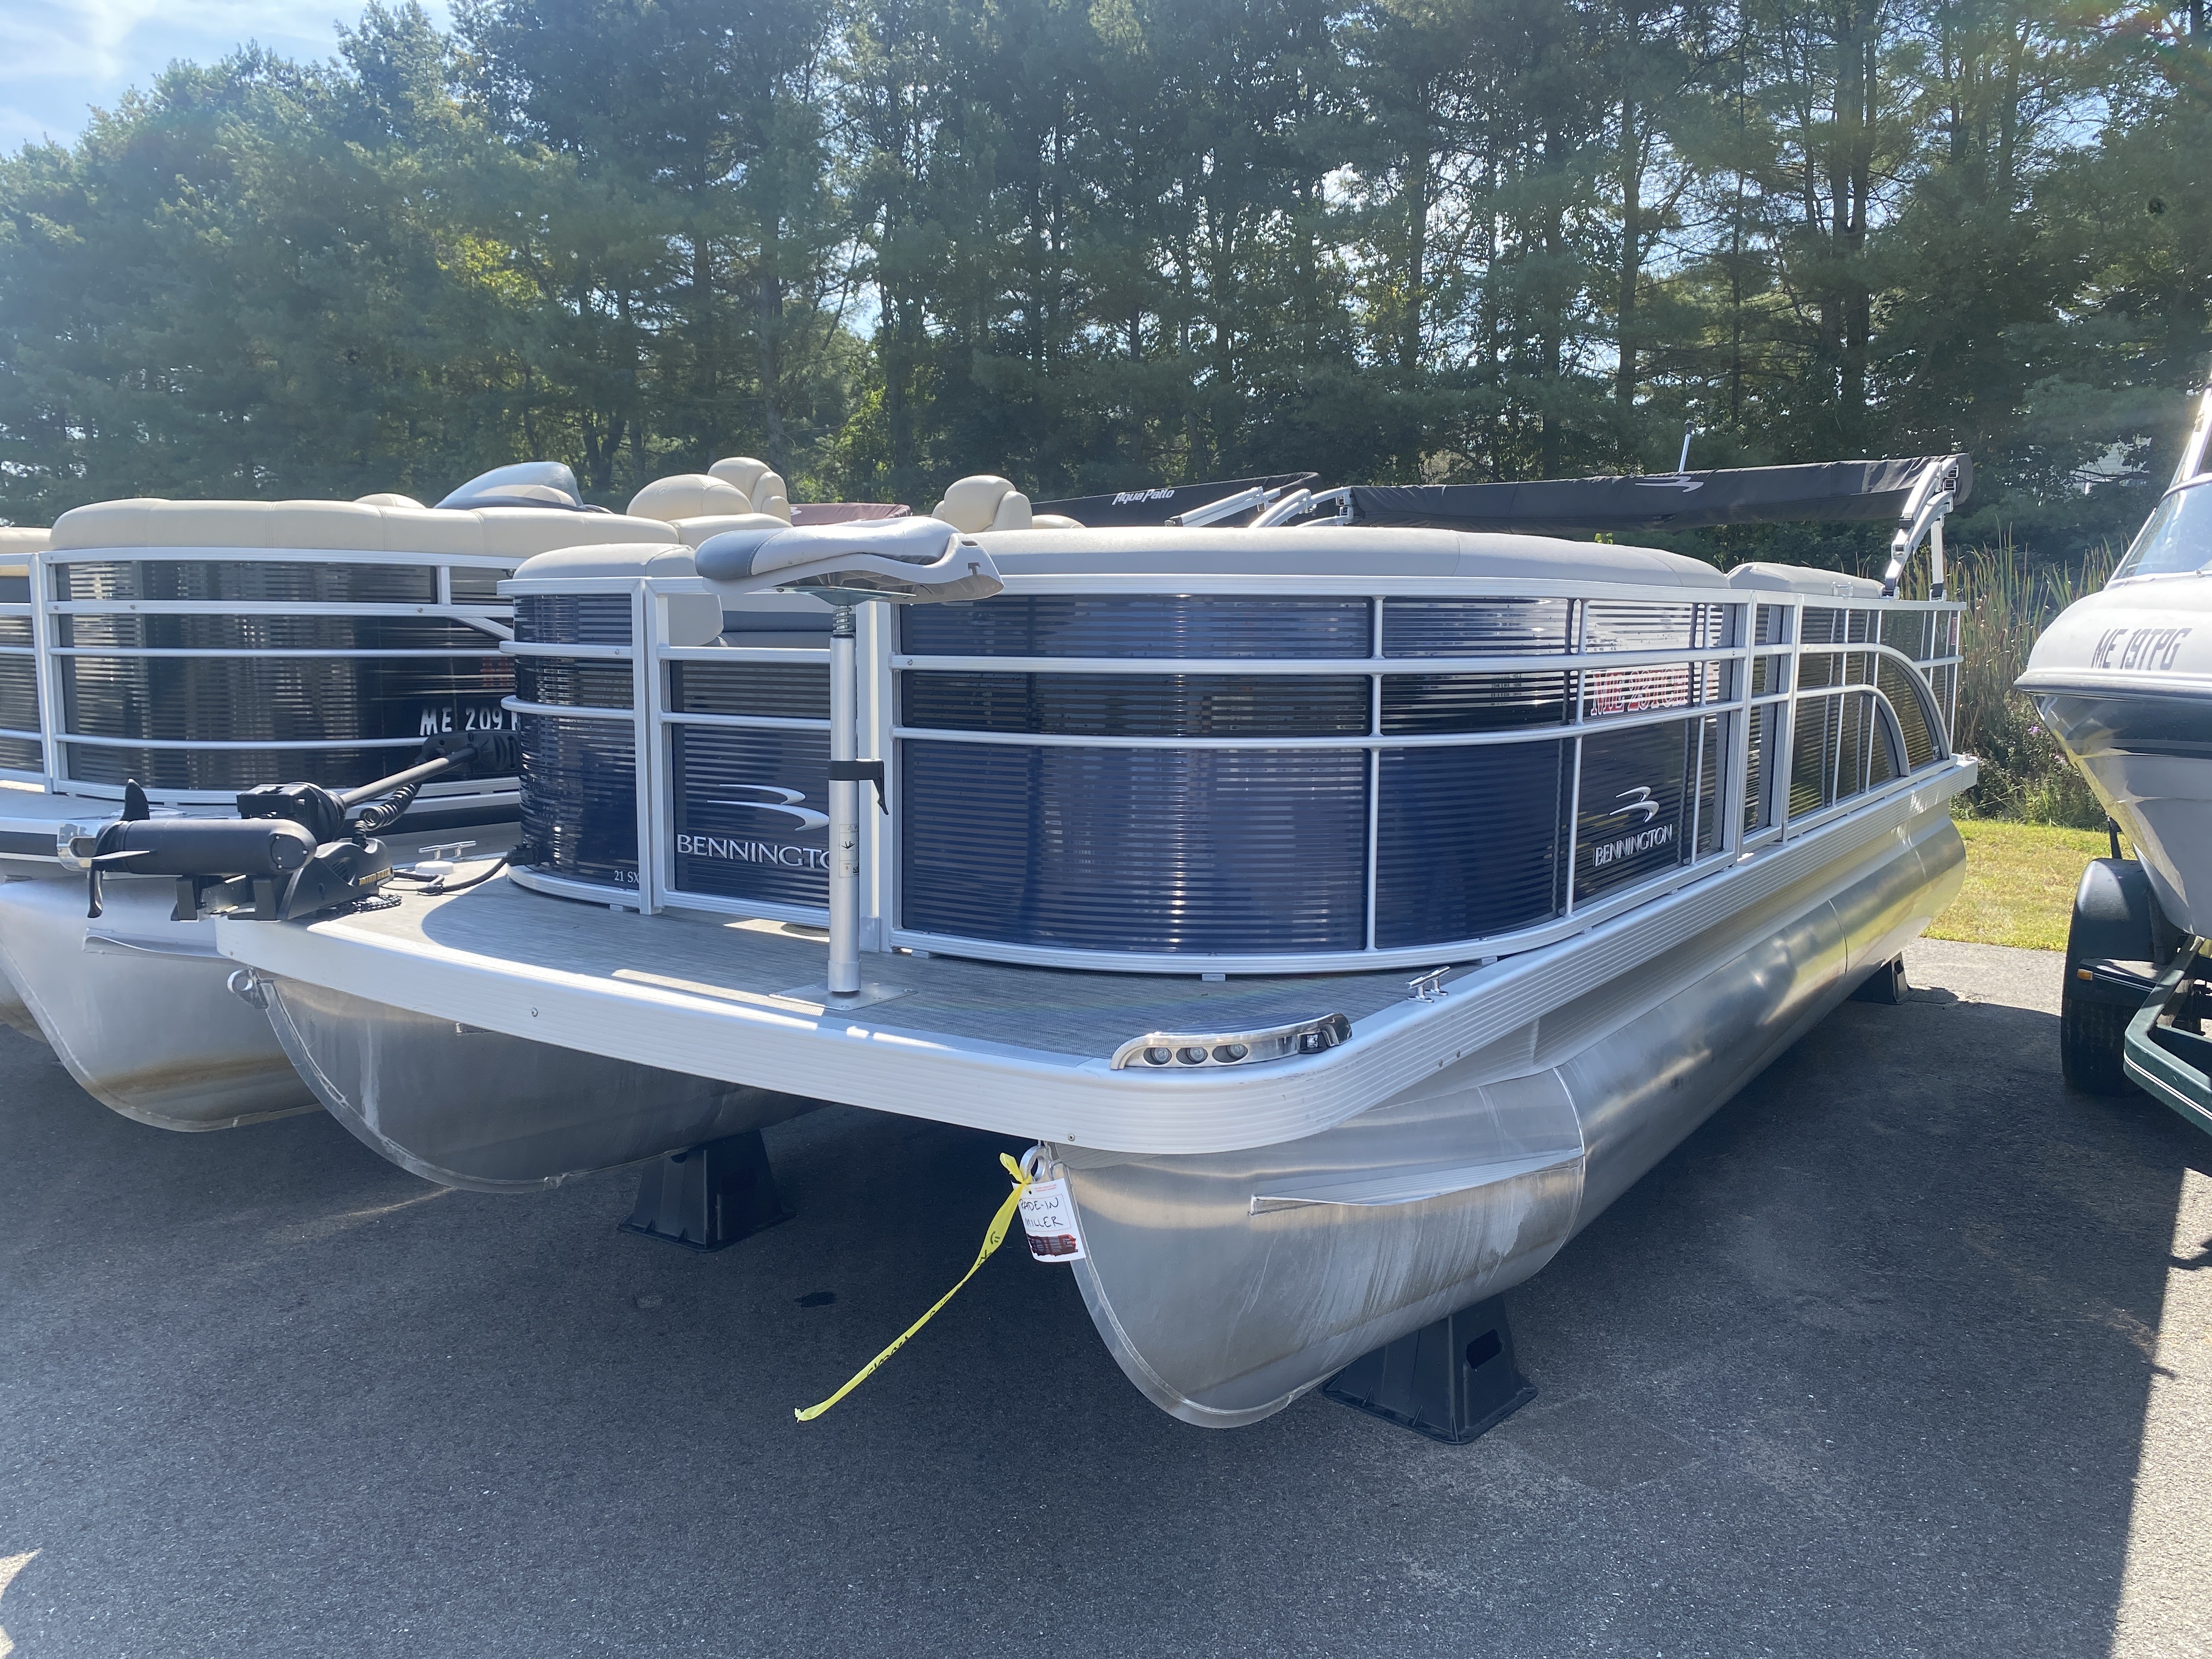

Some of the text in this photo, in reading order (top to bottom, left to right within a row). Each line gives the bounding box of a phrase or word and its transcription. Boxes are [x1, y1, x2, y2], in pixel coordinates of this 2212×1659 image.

[2090, 628, 2193, 670] ME 19TPG
[1590, 670, 1626, 716] ME
[419, 707, 453, 736] ME
[465, 707, 503, 731] 209
[1594, 823, 1673, 867] BENNINGTON
[614, 870, 639, 884] 21 SX
[1018, 1196, 1059, 1211] RADE-IN
[1025, 1216, 1063, 1228] MILLER
